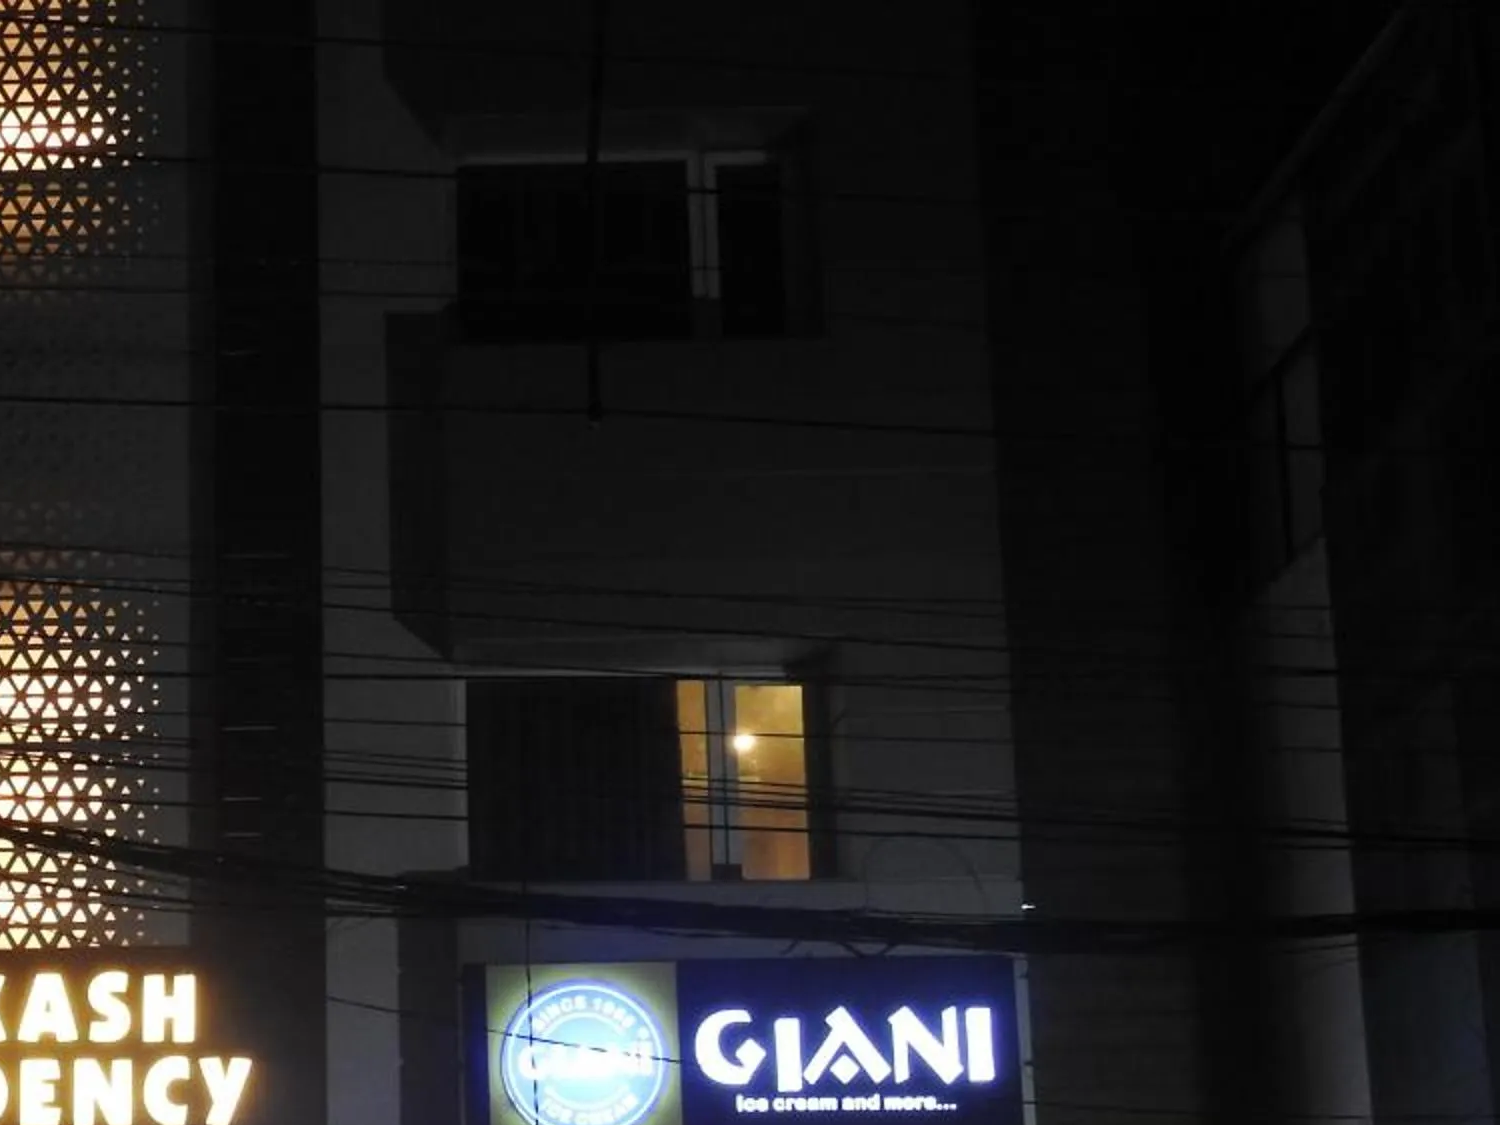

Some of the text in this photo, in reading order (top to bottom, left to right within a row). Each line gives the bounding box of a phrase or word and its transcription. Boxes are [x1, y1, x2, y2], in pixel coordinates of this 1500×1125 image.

[694, 1006, 995, 1092] GIANI
[773, 1097, 838, 1111] cream
[842, 1094, 880, 1111] and
